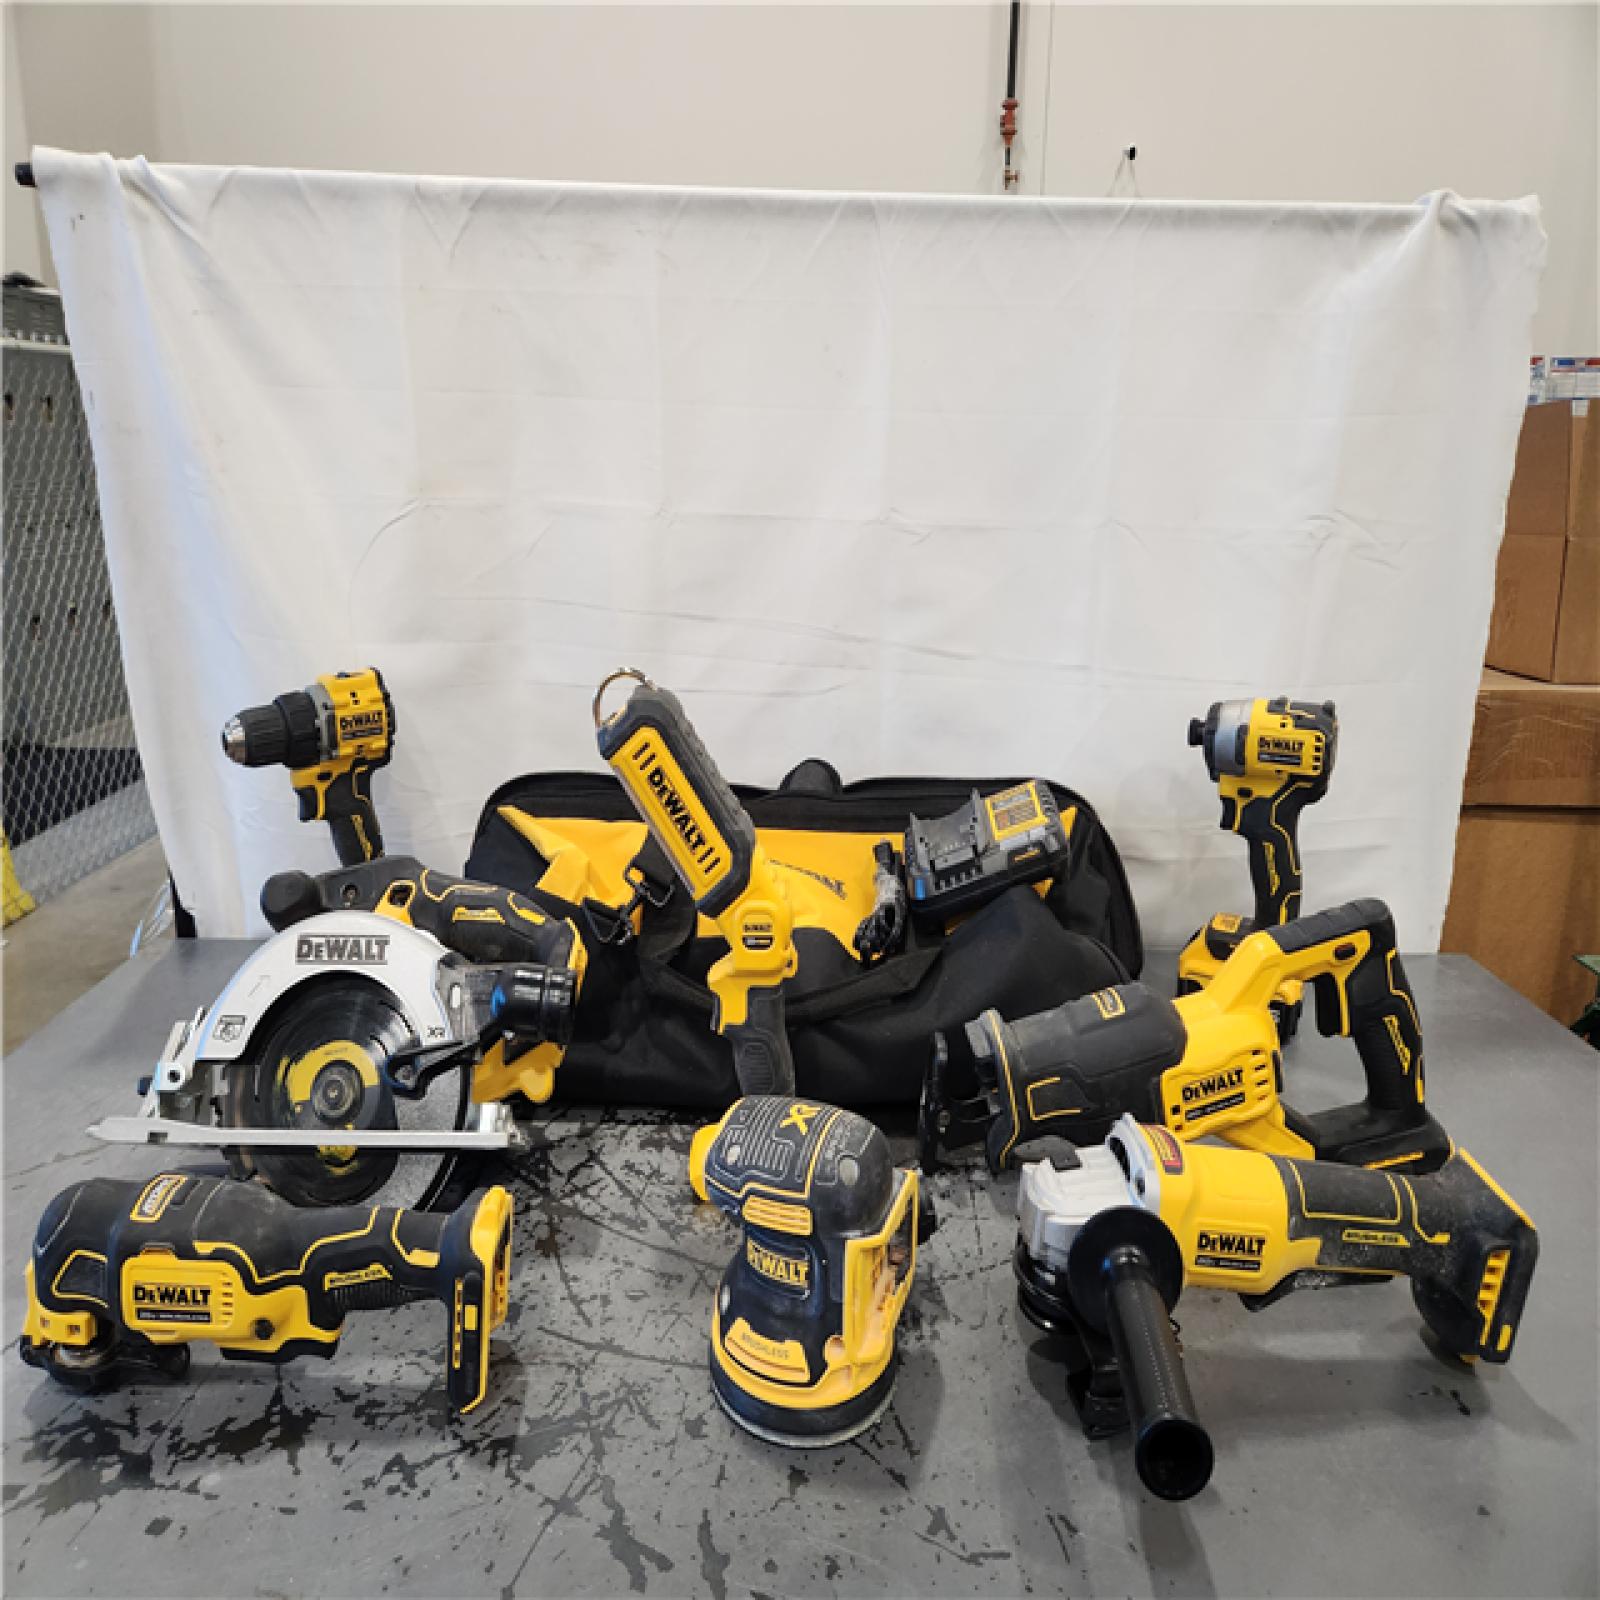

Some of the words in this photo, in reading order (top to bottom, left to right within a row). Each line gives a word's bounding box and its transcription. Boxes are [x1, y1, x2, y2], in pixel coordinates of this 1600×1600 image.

[646, 765, 706, 855] DEWALT
[296, 936, 390, 964] DEWALT
[1182, 1067, 1244, 1102] DEWALT
[1197, 1231, 1265, 1256] DEWALT
[134, 1284, 211, 1306] DEWALT
